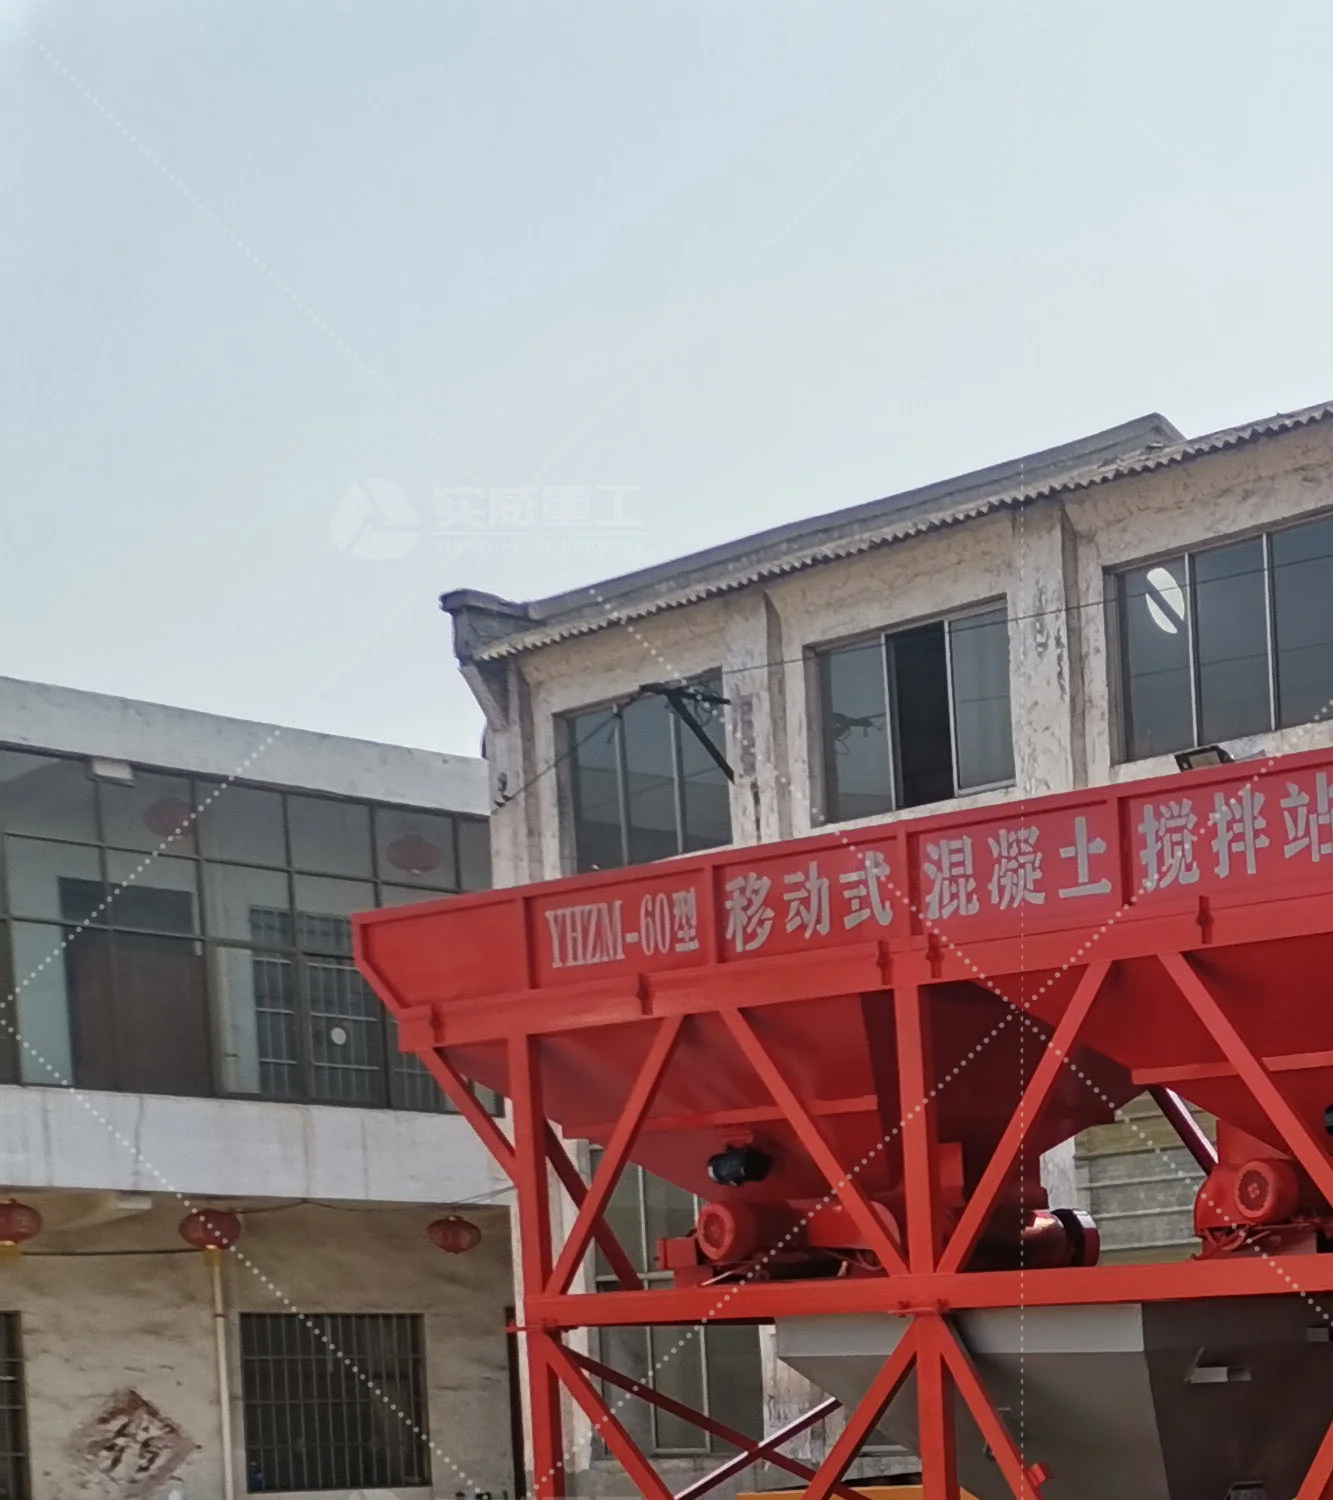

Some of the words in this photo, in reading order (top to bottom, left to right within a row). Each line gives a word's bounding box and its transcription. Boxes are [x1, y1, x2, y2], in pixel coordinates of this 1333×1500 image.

[546, 887, 699, 968] YHZM-60型
[725, 851, 892, 953] 移动式
[923, 816, 1112, 921] 混凝土
